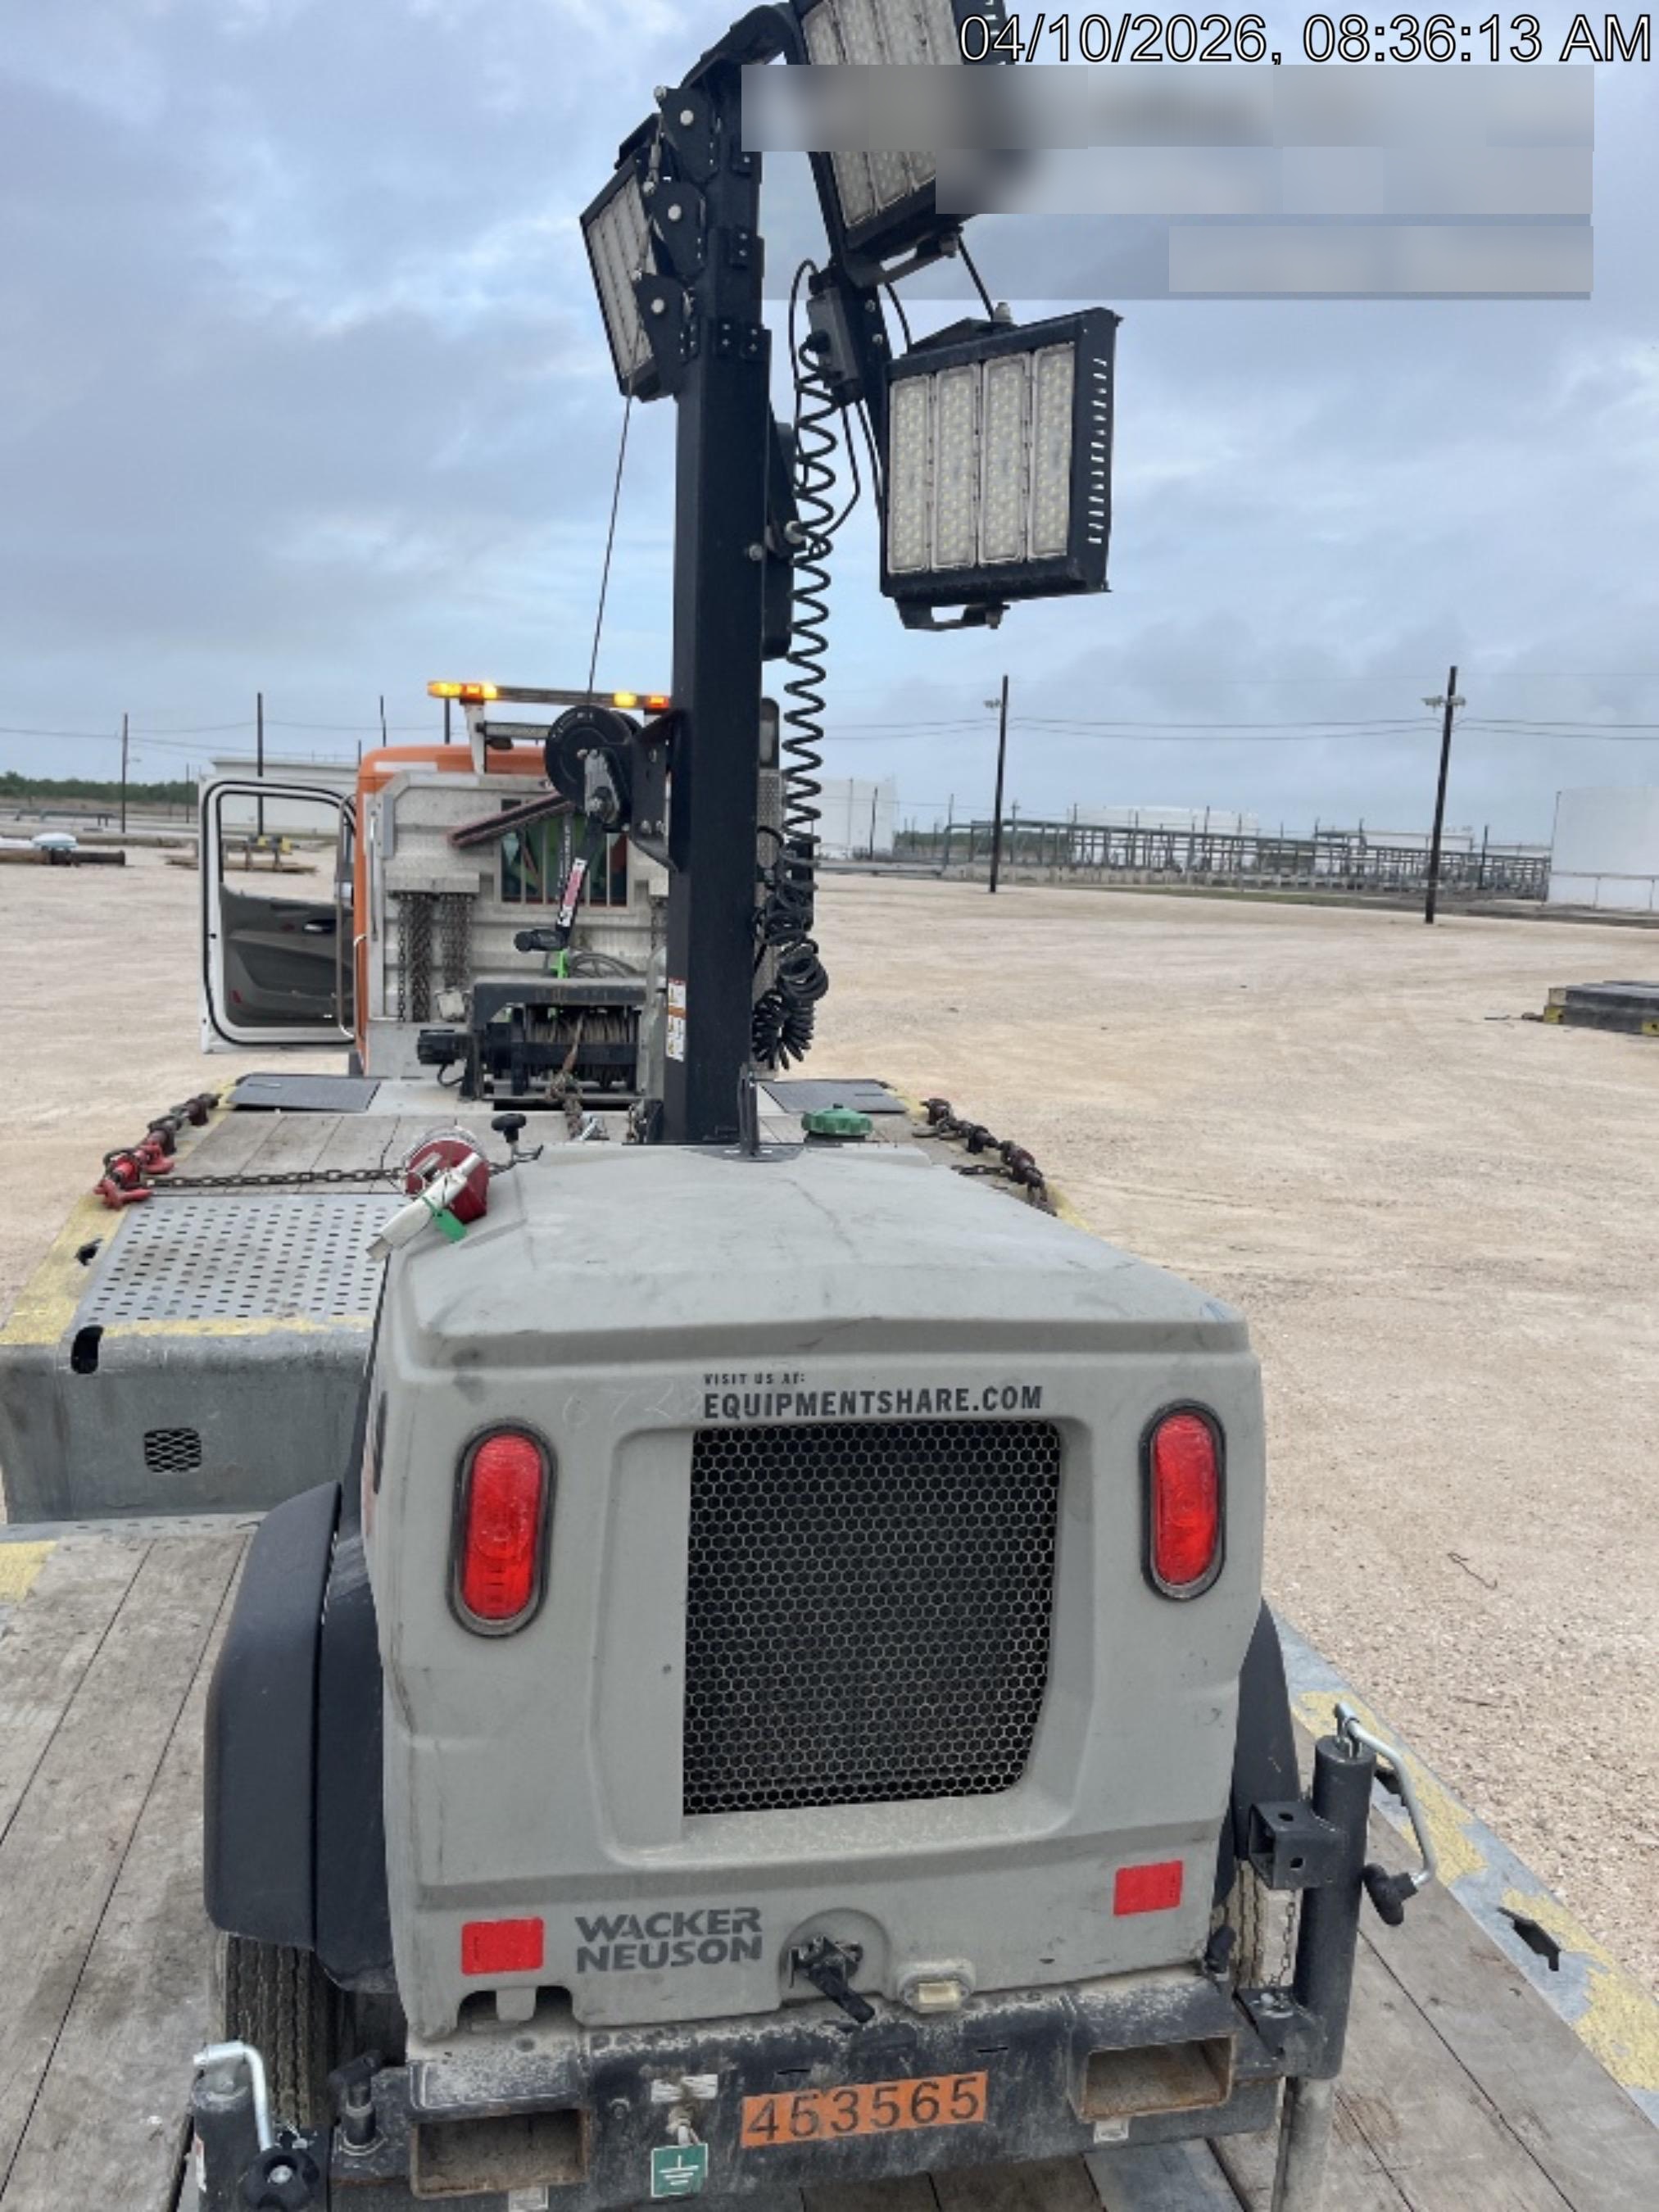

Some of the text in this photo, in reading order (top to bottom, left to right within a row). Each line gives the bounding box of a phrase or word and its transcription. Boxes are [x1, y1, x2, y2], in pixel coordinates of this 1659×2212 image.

[704, 1373, 747, 1385] VISIT
[755, 1372, 773, 1385] US
[704, 1385, 1043, 1421] EQUIPMENTSHARE.COM
[575, 1906, 762, 1942] WACKER
[576, 1936, 763, 1974] NEUSON
